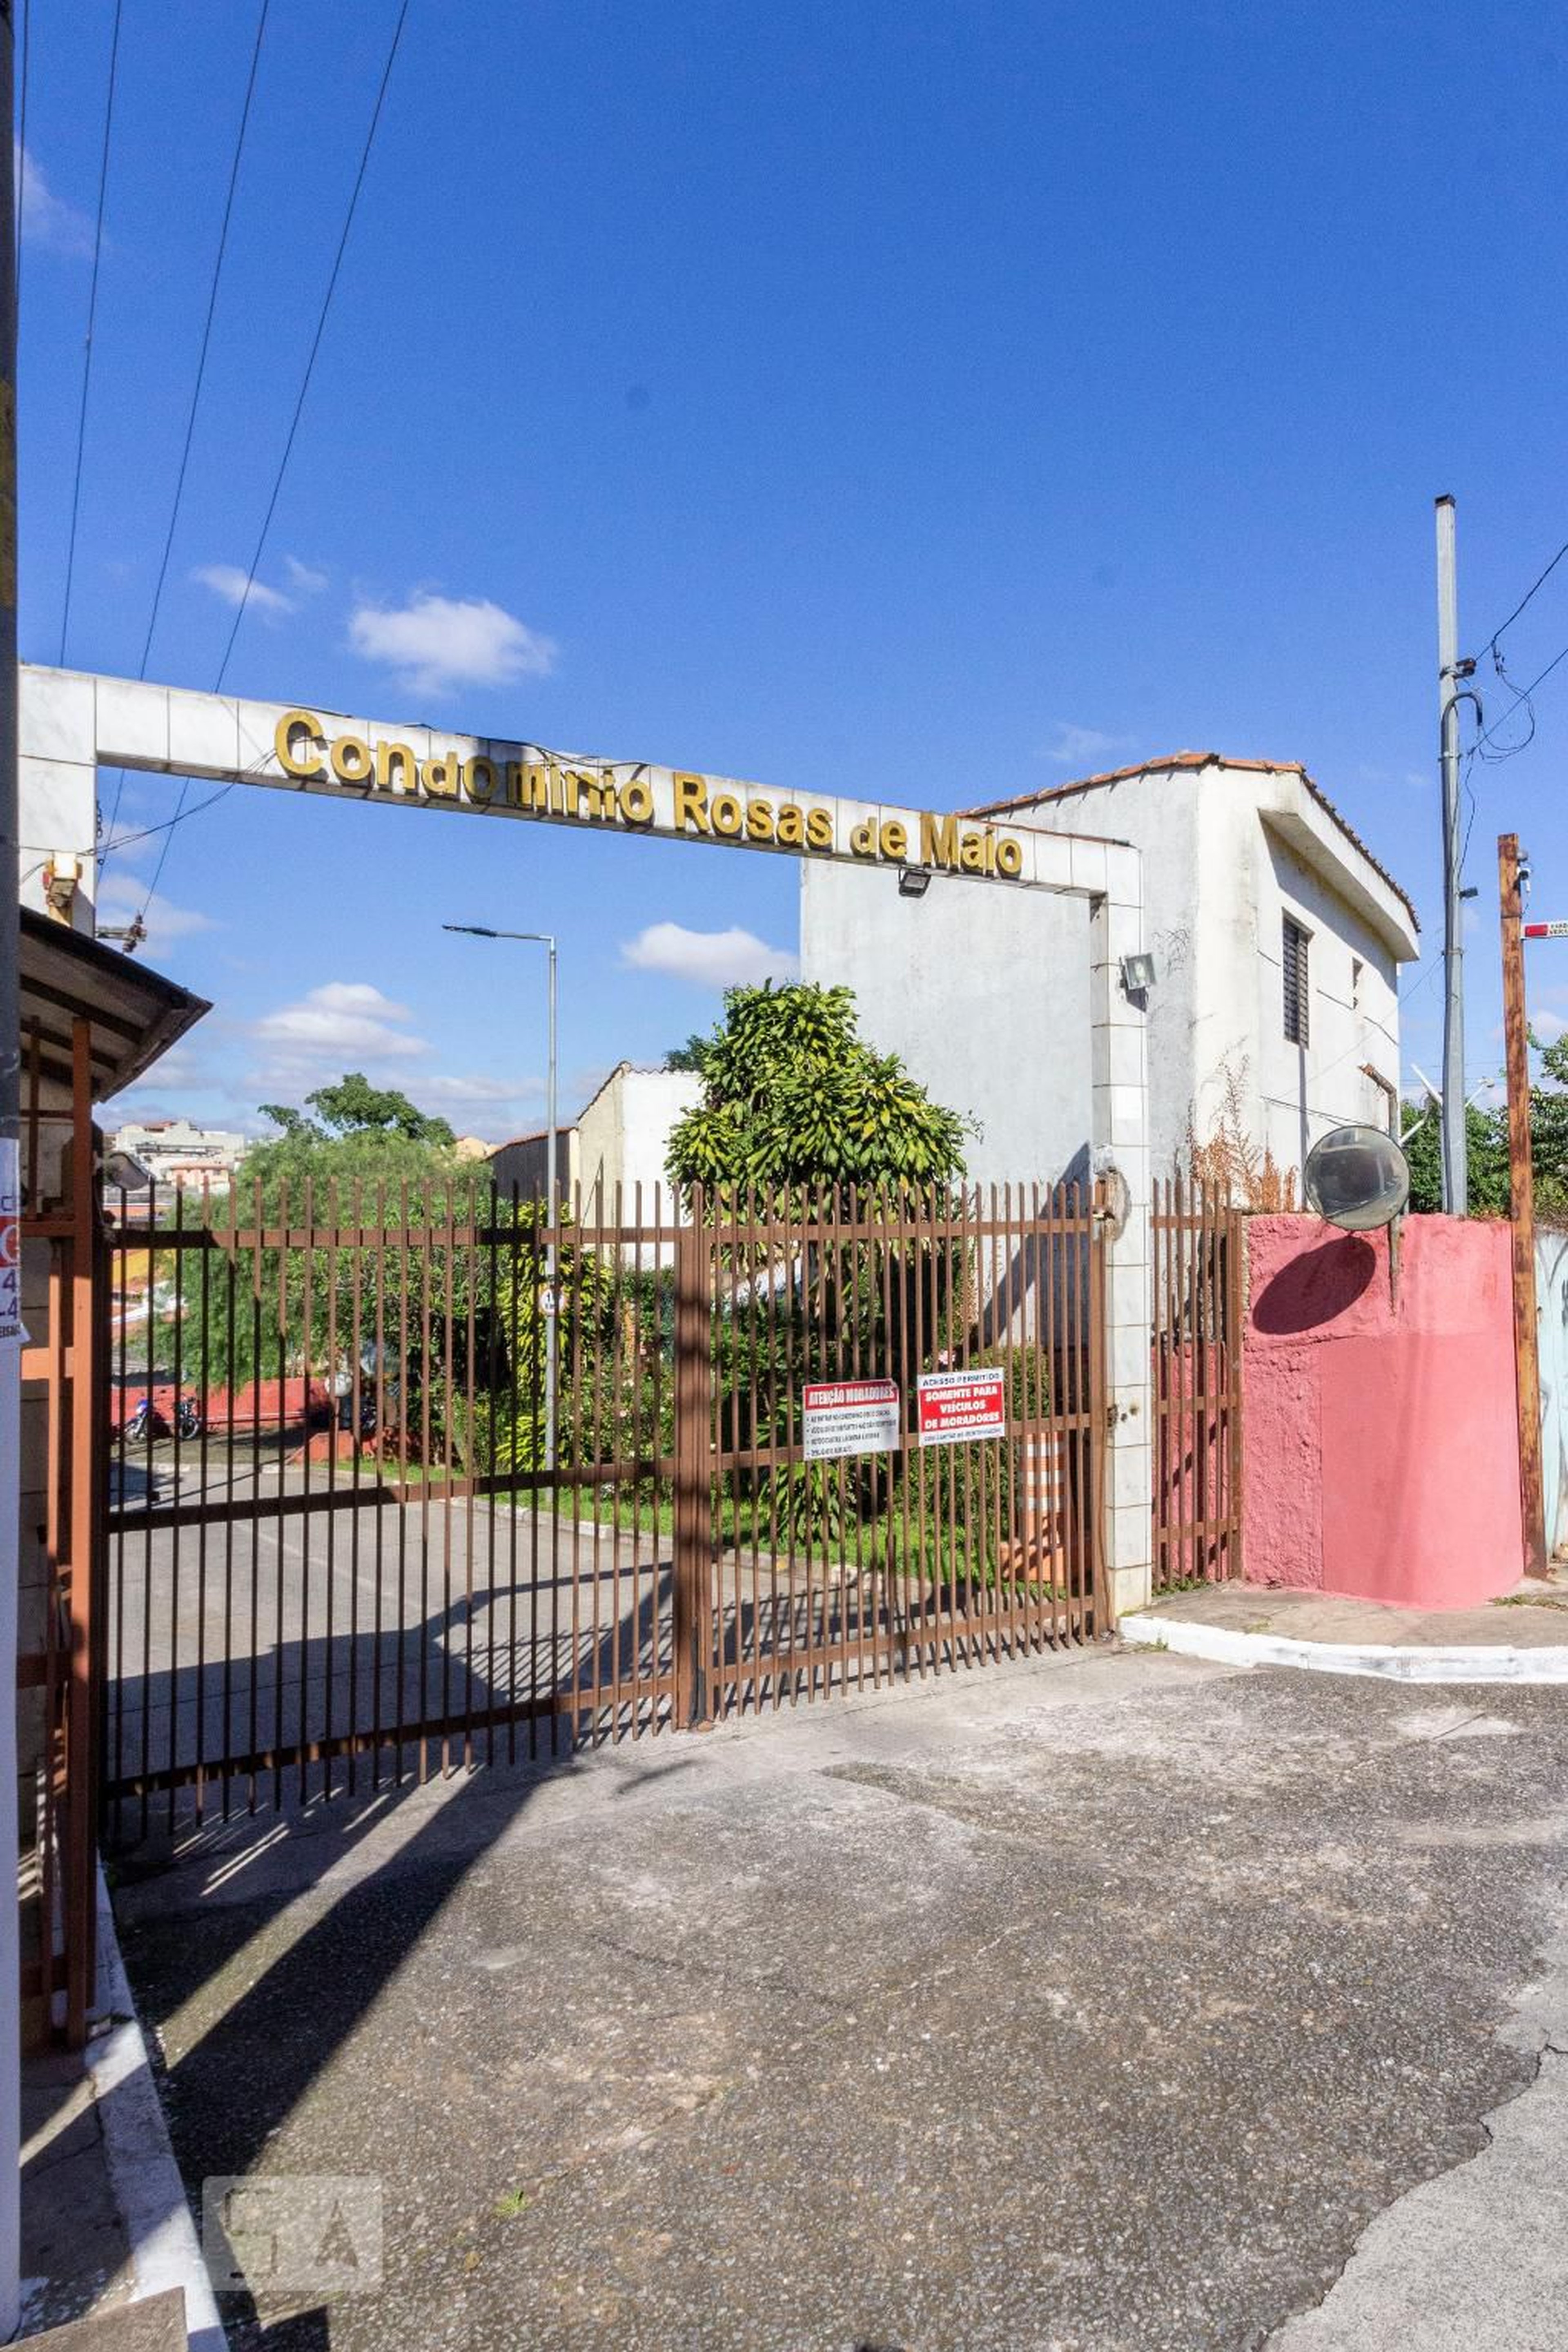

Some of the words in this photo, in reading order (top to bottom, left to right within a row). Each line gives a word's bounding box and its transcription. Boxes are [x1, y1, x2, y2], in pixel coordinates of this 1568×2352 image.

[673, 772, 833, 846] Rosas
[850, 817, 908, 857] de
[920, 812, 1022, 874] Maio
[808, 1387, 844, 1406] ATENÇÃO
[926, 1388, 971, 1402] SOMENTE
[973, 1385, 998, 1396] PARA
[940, 1399, 986, 1414] VEÍCULOS
[924, 1419, 938, 1429] DE
[940, 1412, 999, 1428] MORADORES
